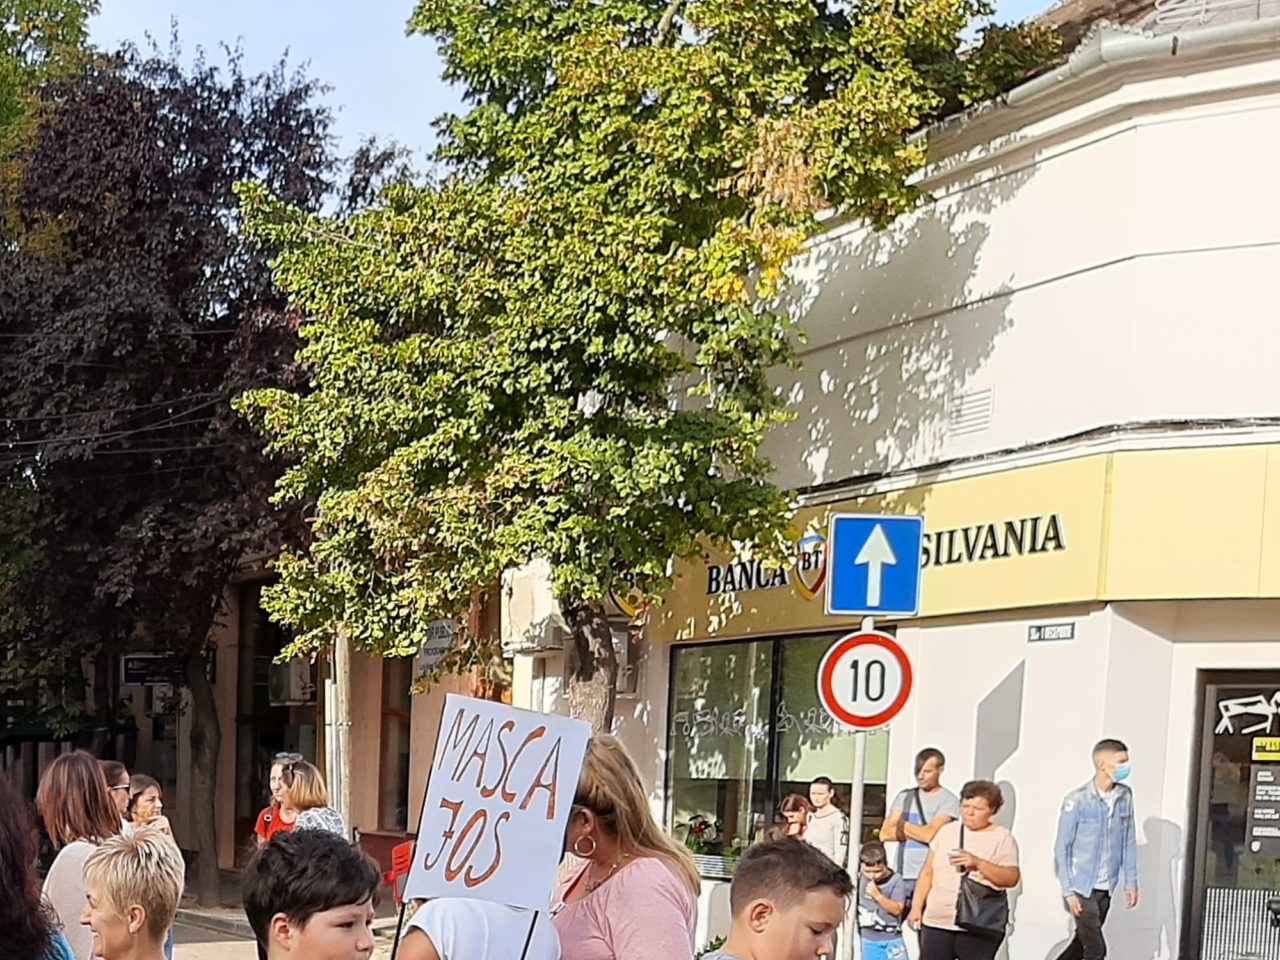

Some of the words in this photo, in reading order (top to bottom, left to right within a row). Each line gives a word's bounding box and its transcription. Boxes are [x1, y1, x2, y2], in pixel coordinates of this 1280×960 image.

[706, 559, 788, 595] BANCA
[801, 550, 822, 571] BT
[850, 659, 886, 702] 10
[438, 708, 562, 819] MASCA
[423, 797, 510, 888] JOS
